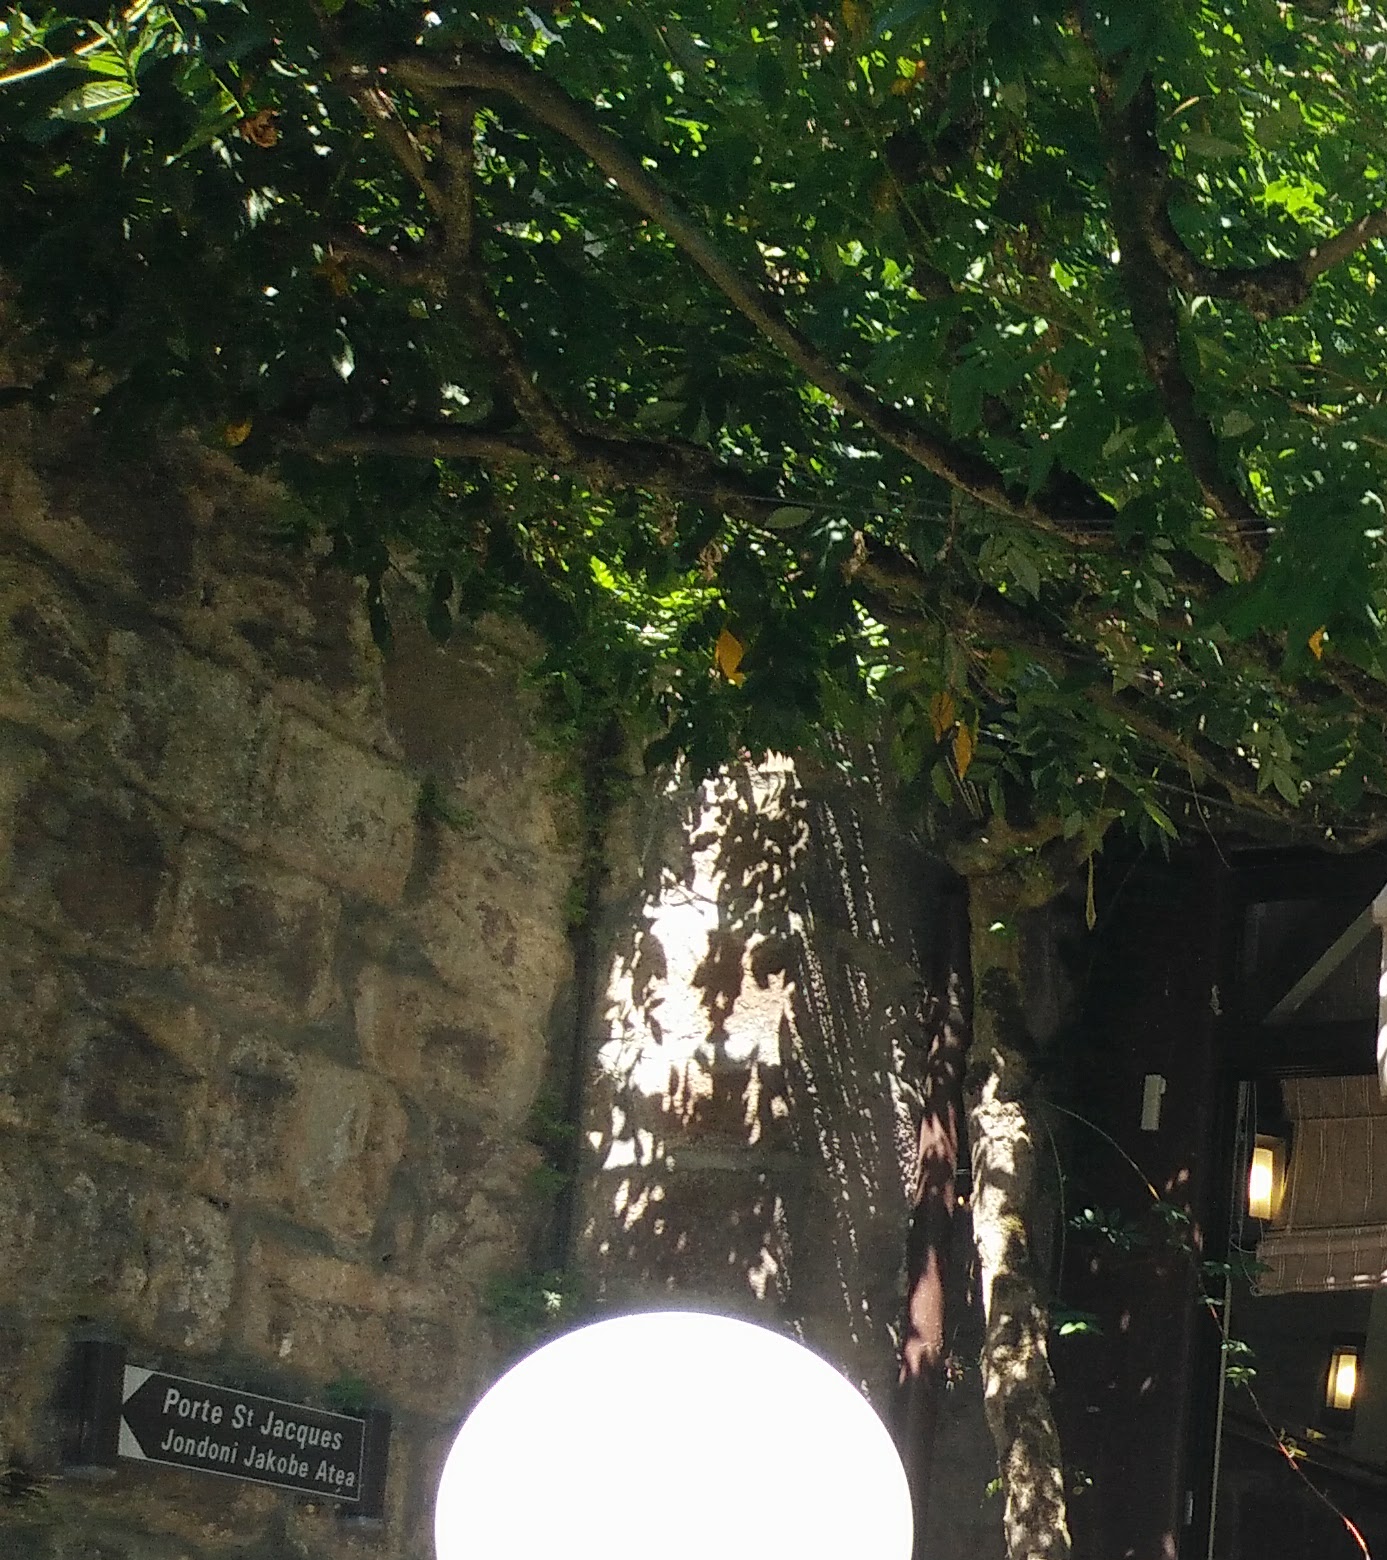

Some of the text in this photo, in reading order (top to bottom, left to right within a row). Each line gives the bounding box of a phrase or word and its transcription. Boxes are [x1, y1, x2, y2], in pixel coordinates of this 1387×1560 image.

[162, 1388, 344, 1450] Porte St Jacques
[161, 1430, 356, 1487] Jondoni Jakobe Atea
